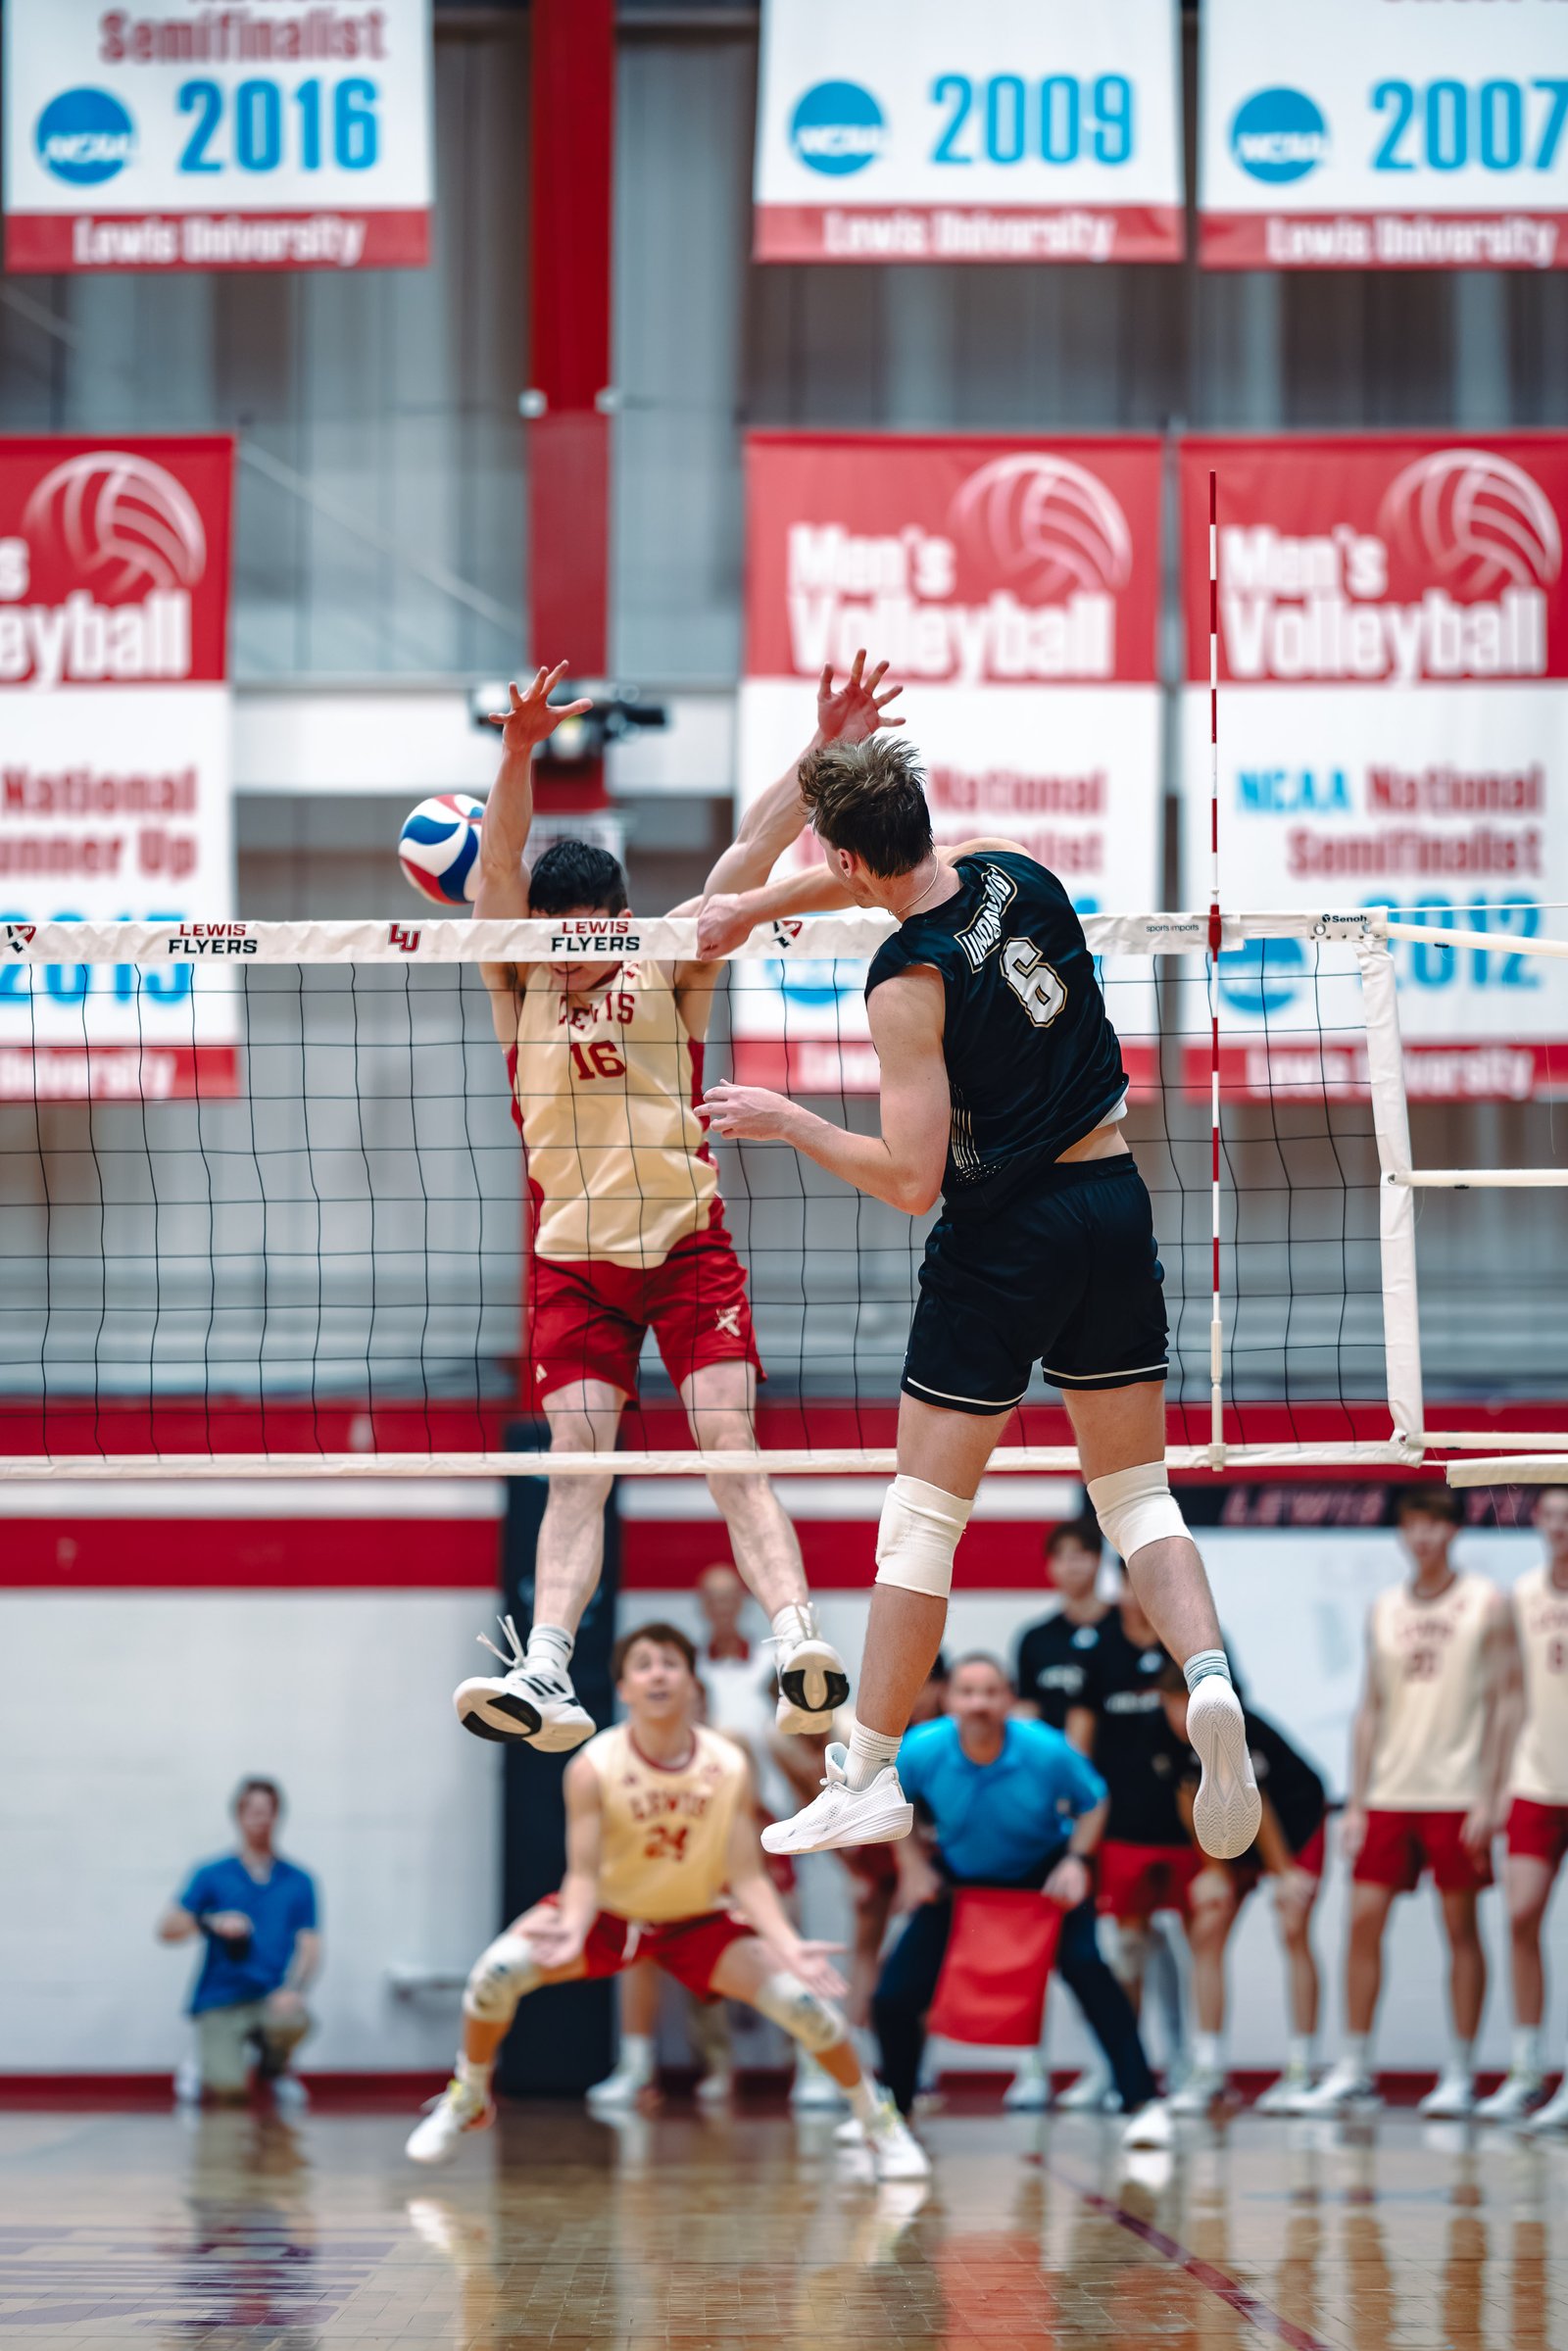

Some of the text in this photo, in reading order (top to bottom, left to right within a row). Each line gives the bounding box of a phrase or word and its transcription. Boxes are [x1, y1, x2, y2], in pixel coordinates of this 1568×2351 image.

[99, 10, 387, 63] Semifinalist
[176, 78, 378, 172] 2016
[928, 74, 1133, 165] 2009
[1372, 80, 1568, 170] 2007
[74, 214, 366, 267] Lewis University
[823, 209, 1115, 262] Lewis University
[1267, 216, 1559, 269] Lewis University
[789, 522, 956, 597] Men's
[1222, 526, 1387, 599] Men's
[789, 589, 1115, 690] Volleyball
[1223, 589, 1546, 690] Volleyball
[2, 764, 198, 815] National
[932, 766, 1103, 813] National
[1236, 765, 1544, 815] NCAA National
[139, 828, 198, 885] Up
[1288, 825, 1544, 876] Semifinalist
[179, 923, 247, 937] LEWIS
[388, 922, 421, 954] LU
[551, 936, 640, 952] FLYERS
[562, 920, 629, 935] LEWIS
[1146, 923, 1200, 933] sports imports
[1331, 914, 1367, 923] Senoh
[168, 939, 258, 955] FLYERS
[1000, 937, 1068, 1028] 6
[569, 1041, 626, 1080] 16
[644, 1824, 690, 1862] 24
